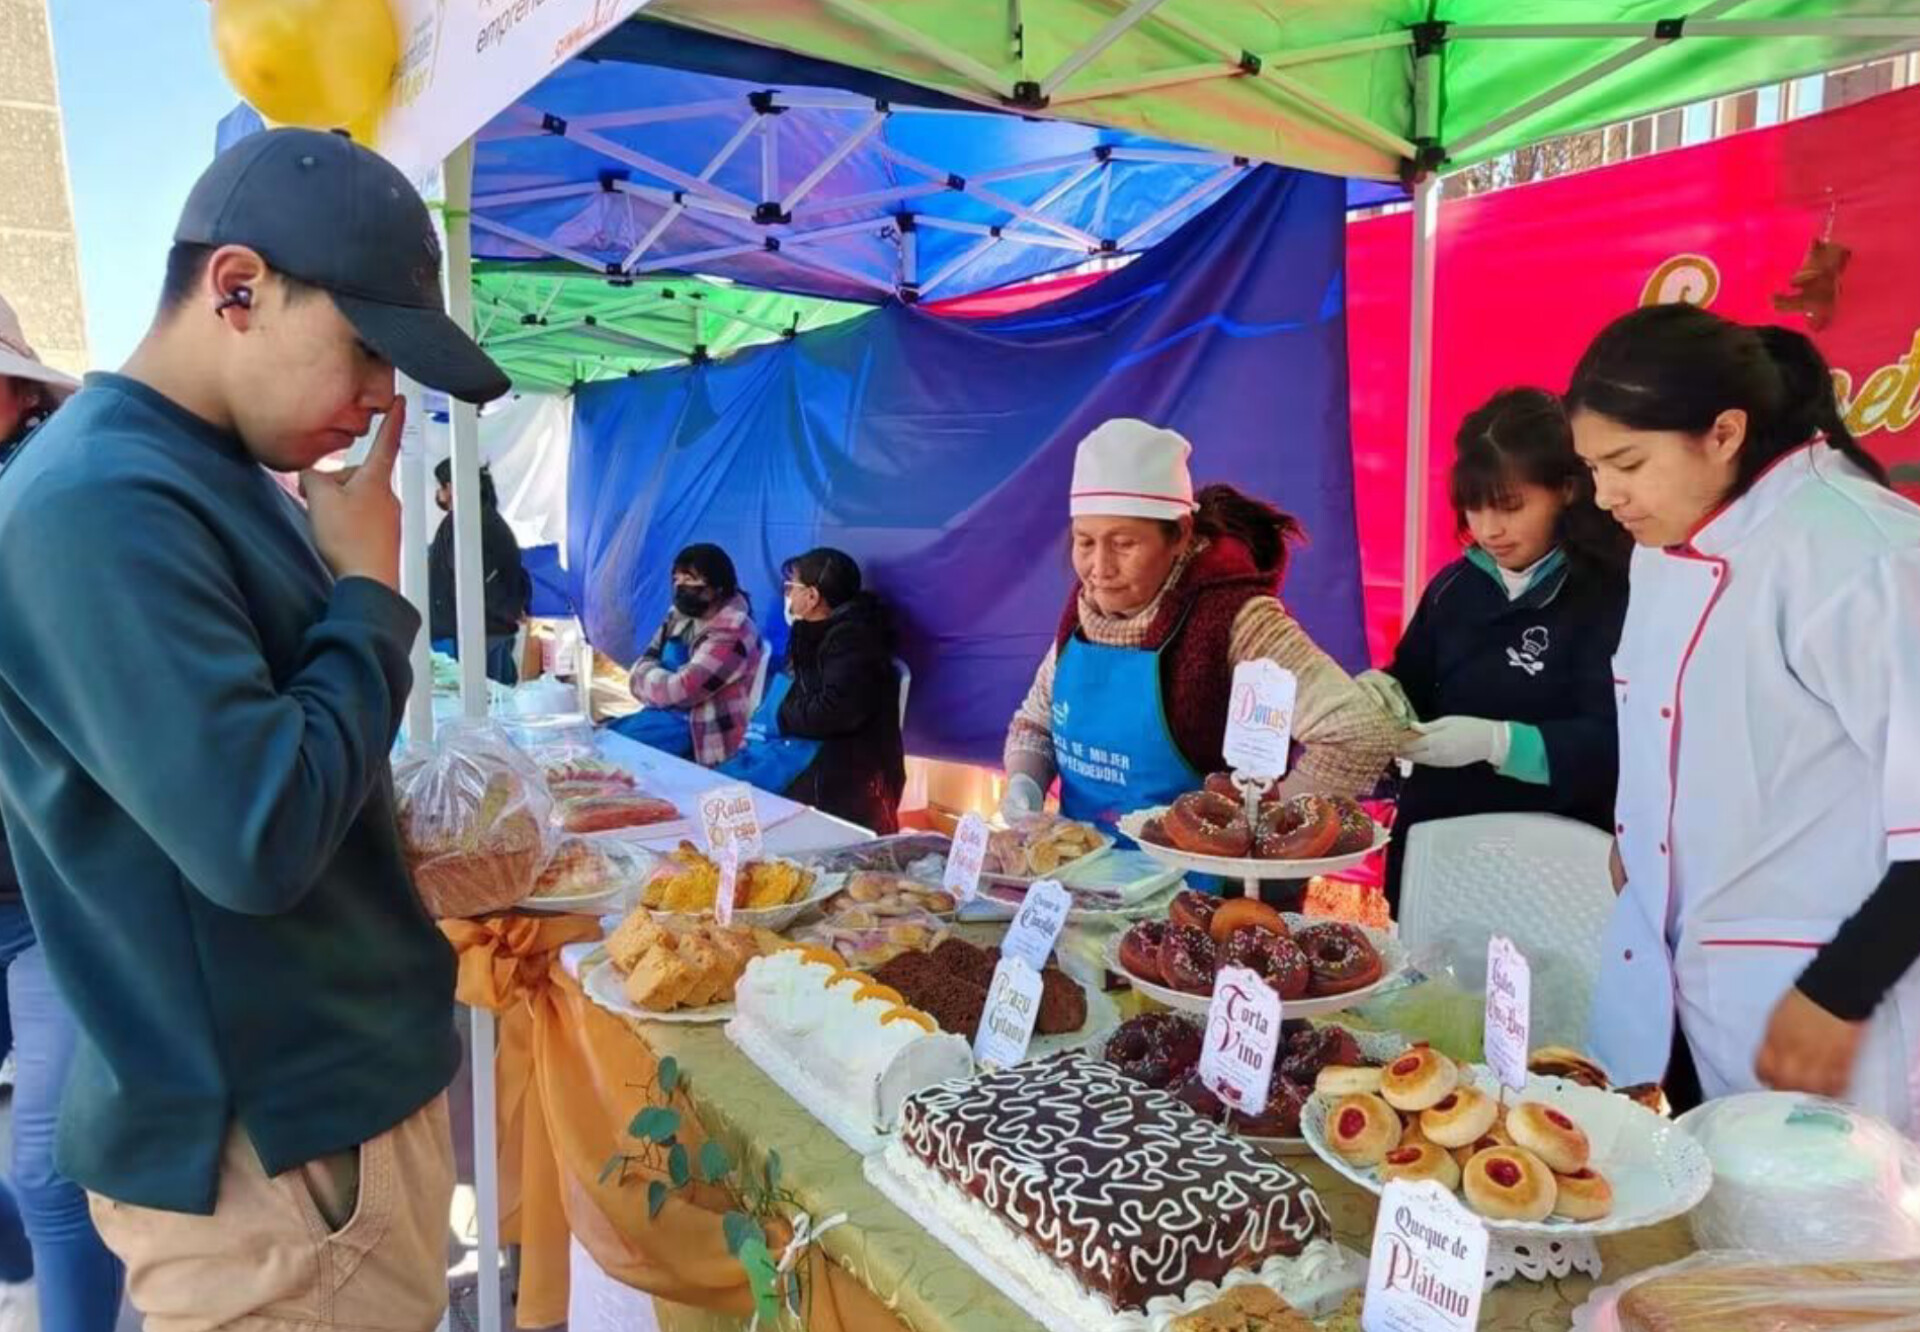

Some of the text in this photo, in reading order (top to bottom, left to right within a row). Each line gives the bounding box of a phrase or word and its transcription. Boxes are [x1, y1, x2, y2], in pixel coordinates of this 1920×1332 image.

[1089, 746, 1131, 771] MUJER
[1220, 984, 1269, 1035] Torta
[1211, 1016, 1263, 1070] Vino
[1394, 1205, 1469, 1261] Queque de
[1383, 1231, 1471, 1318] Plátano
